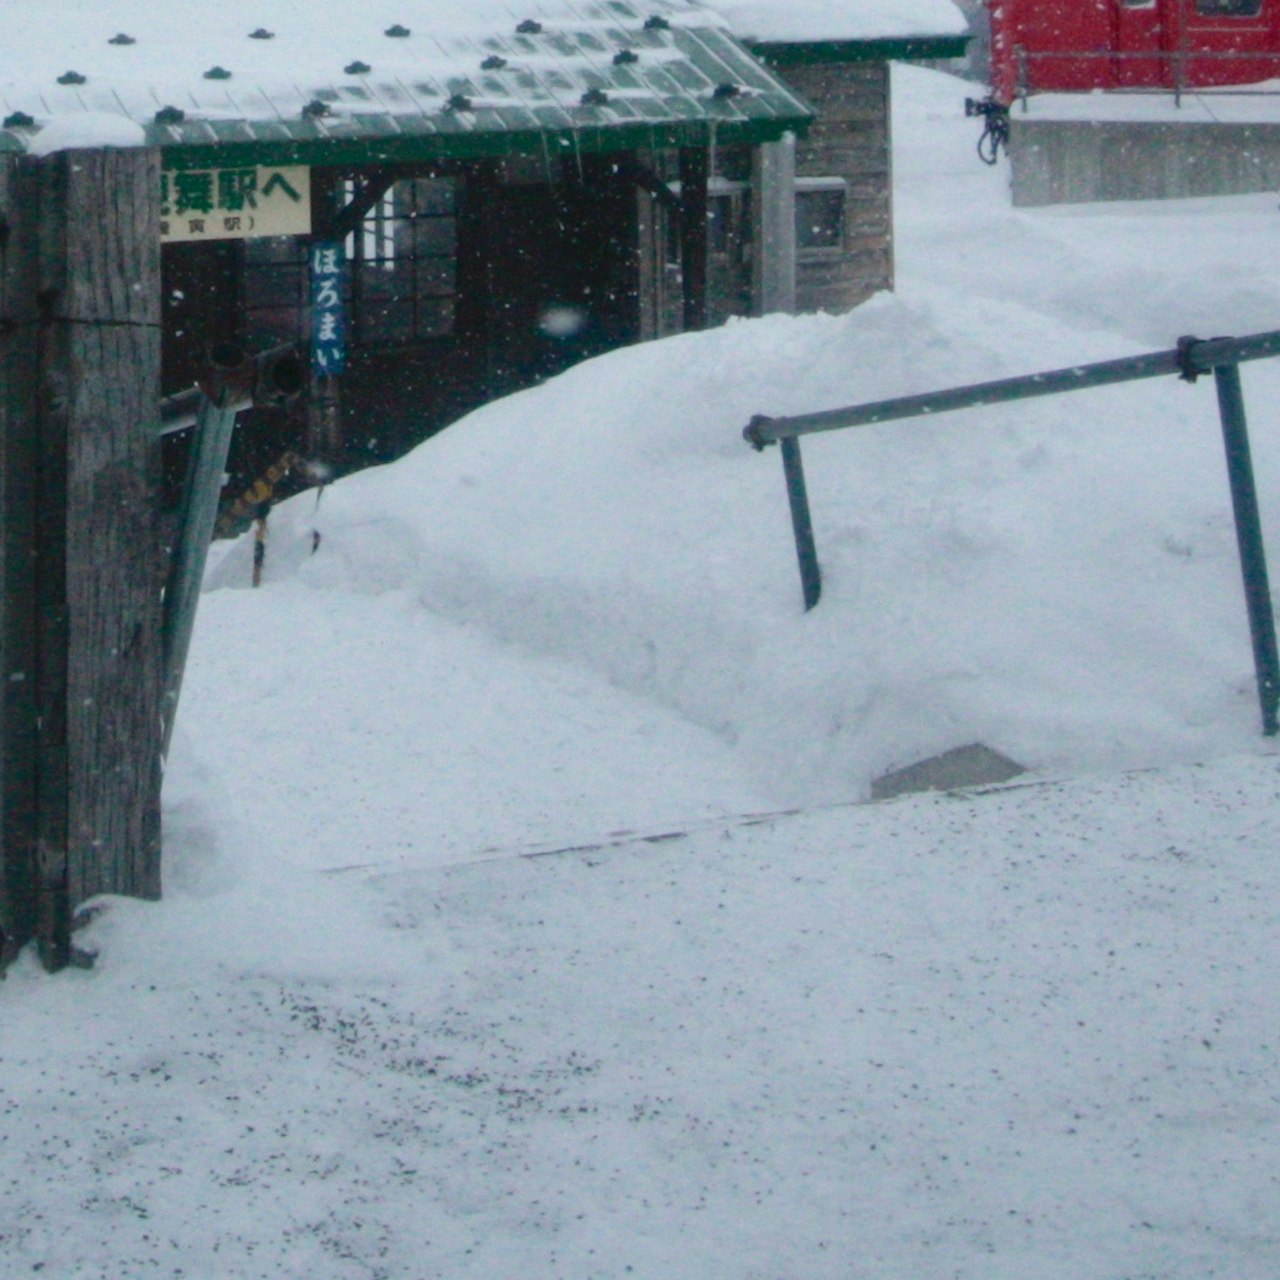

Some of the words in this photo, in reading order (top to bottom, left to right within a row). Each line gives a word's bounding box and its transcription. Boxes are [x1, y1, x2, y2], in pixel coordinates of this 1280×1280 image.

[160, 169, 302, 215] 舞駅へ
[314, 248, 340, 367] ほろまい
